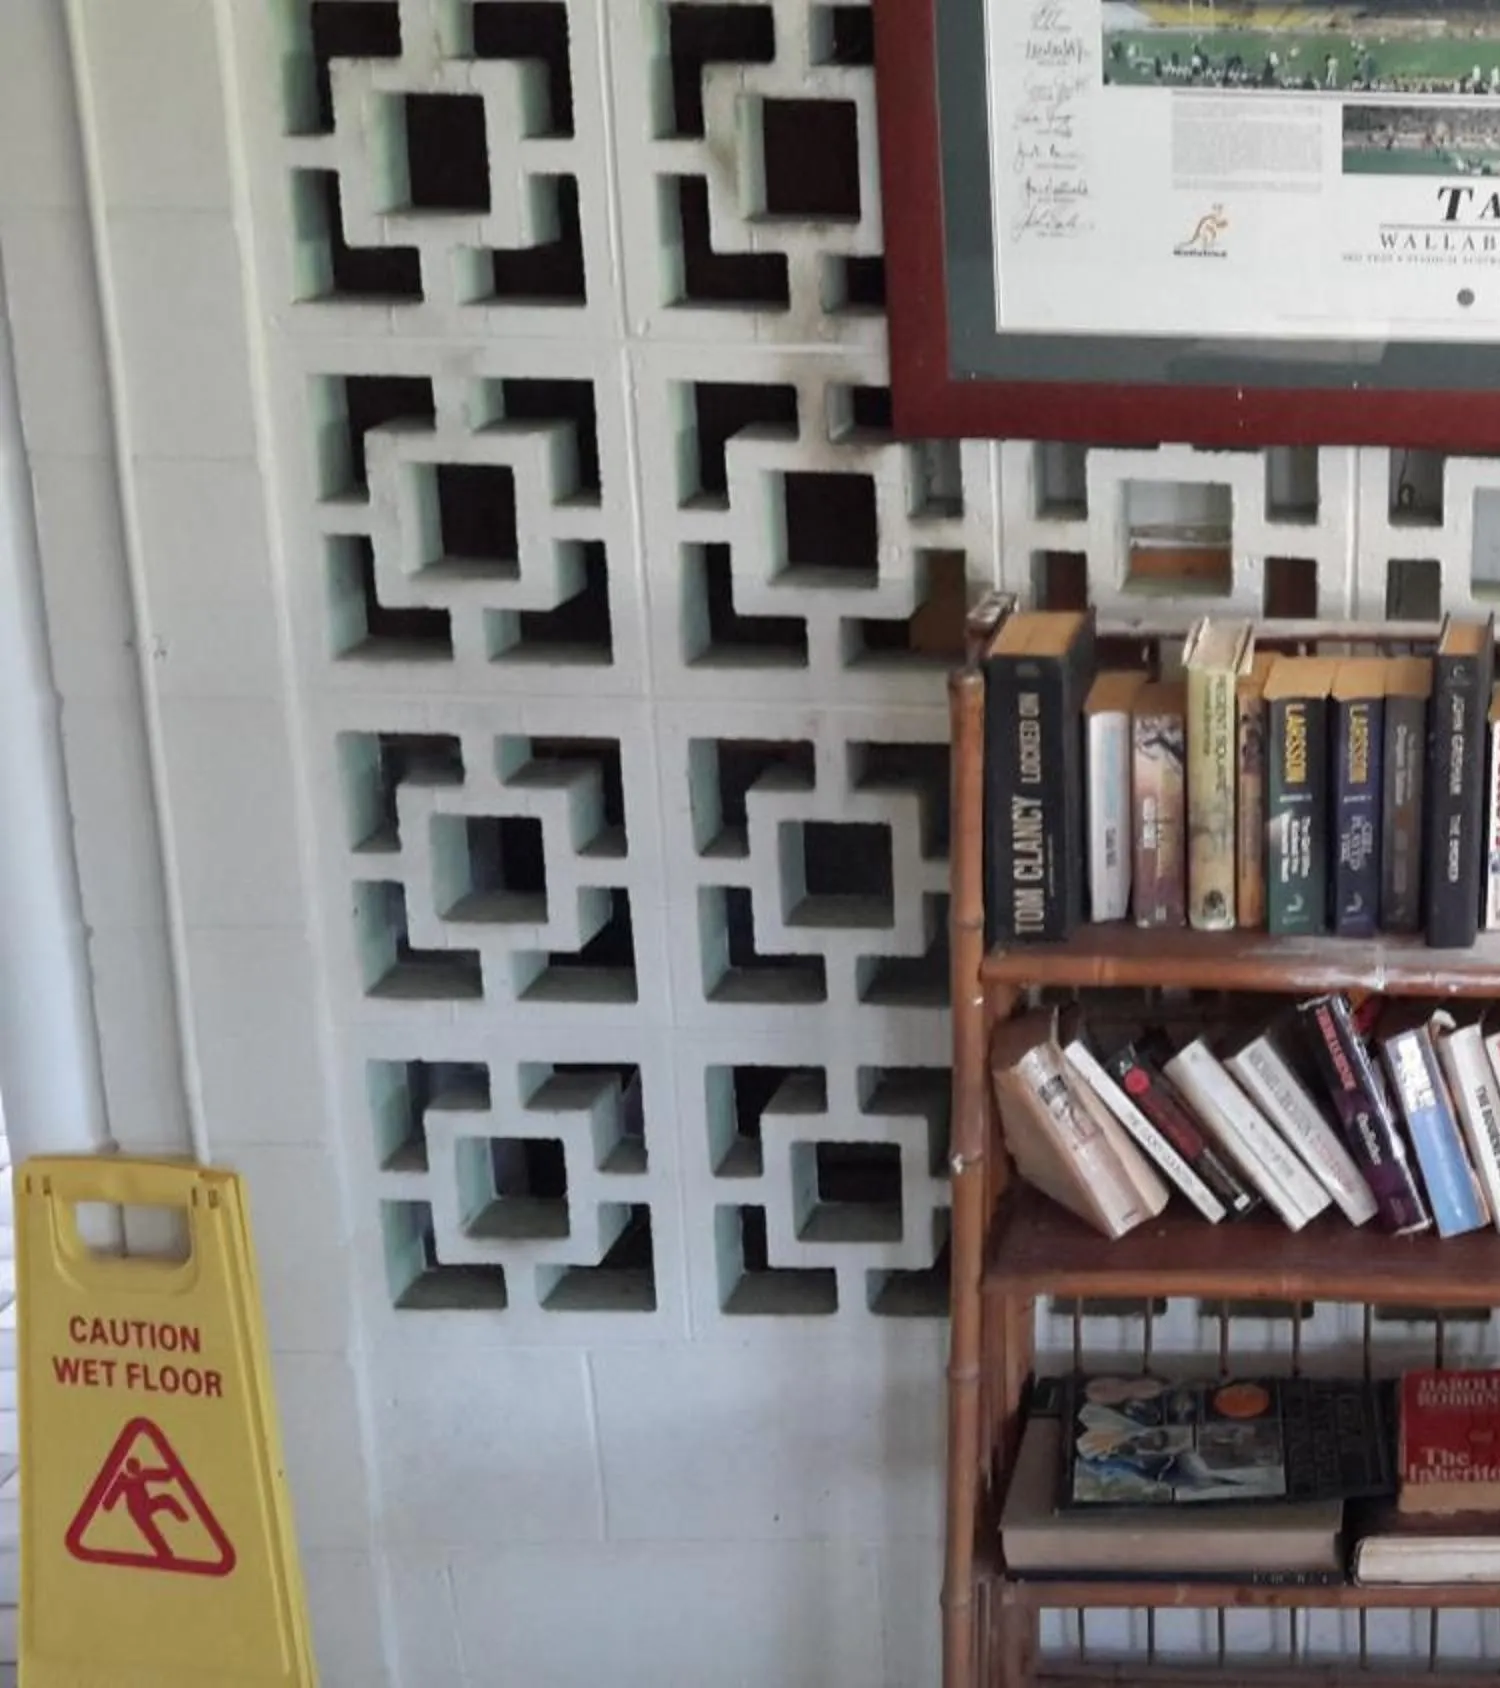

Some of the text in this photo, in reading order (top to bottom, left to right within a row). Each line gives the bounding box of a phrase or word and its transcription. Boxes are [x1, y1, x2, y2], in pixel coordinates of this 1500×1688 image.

[1452, 692, 1465, 732] JOHN
[1020, 719, 1042, 785] LOCKED
[1012, 795, 1045, 936] TOM CLANCY
[69, 1315, 201, 1354] CAUTION
[52, 1355, 223, 1399] WET FLOOR
[1423, 1446, 1470, 1466] The
